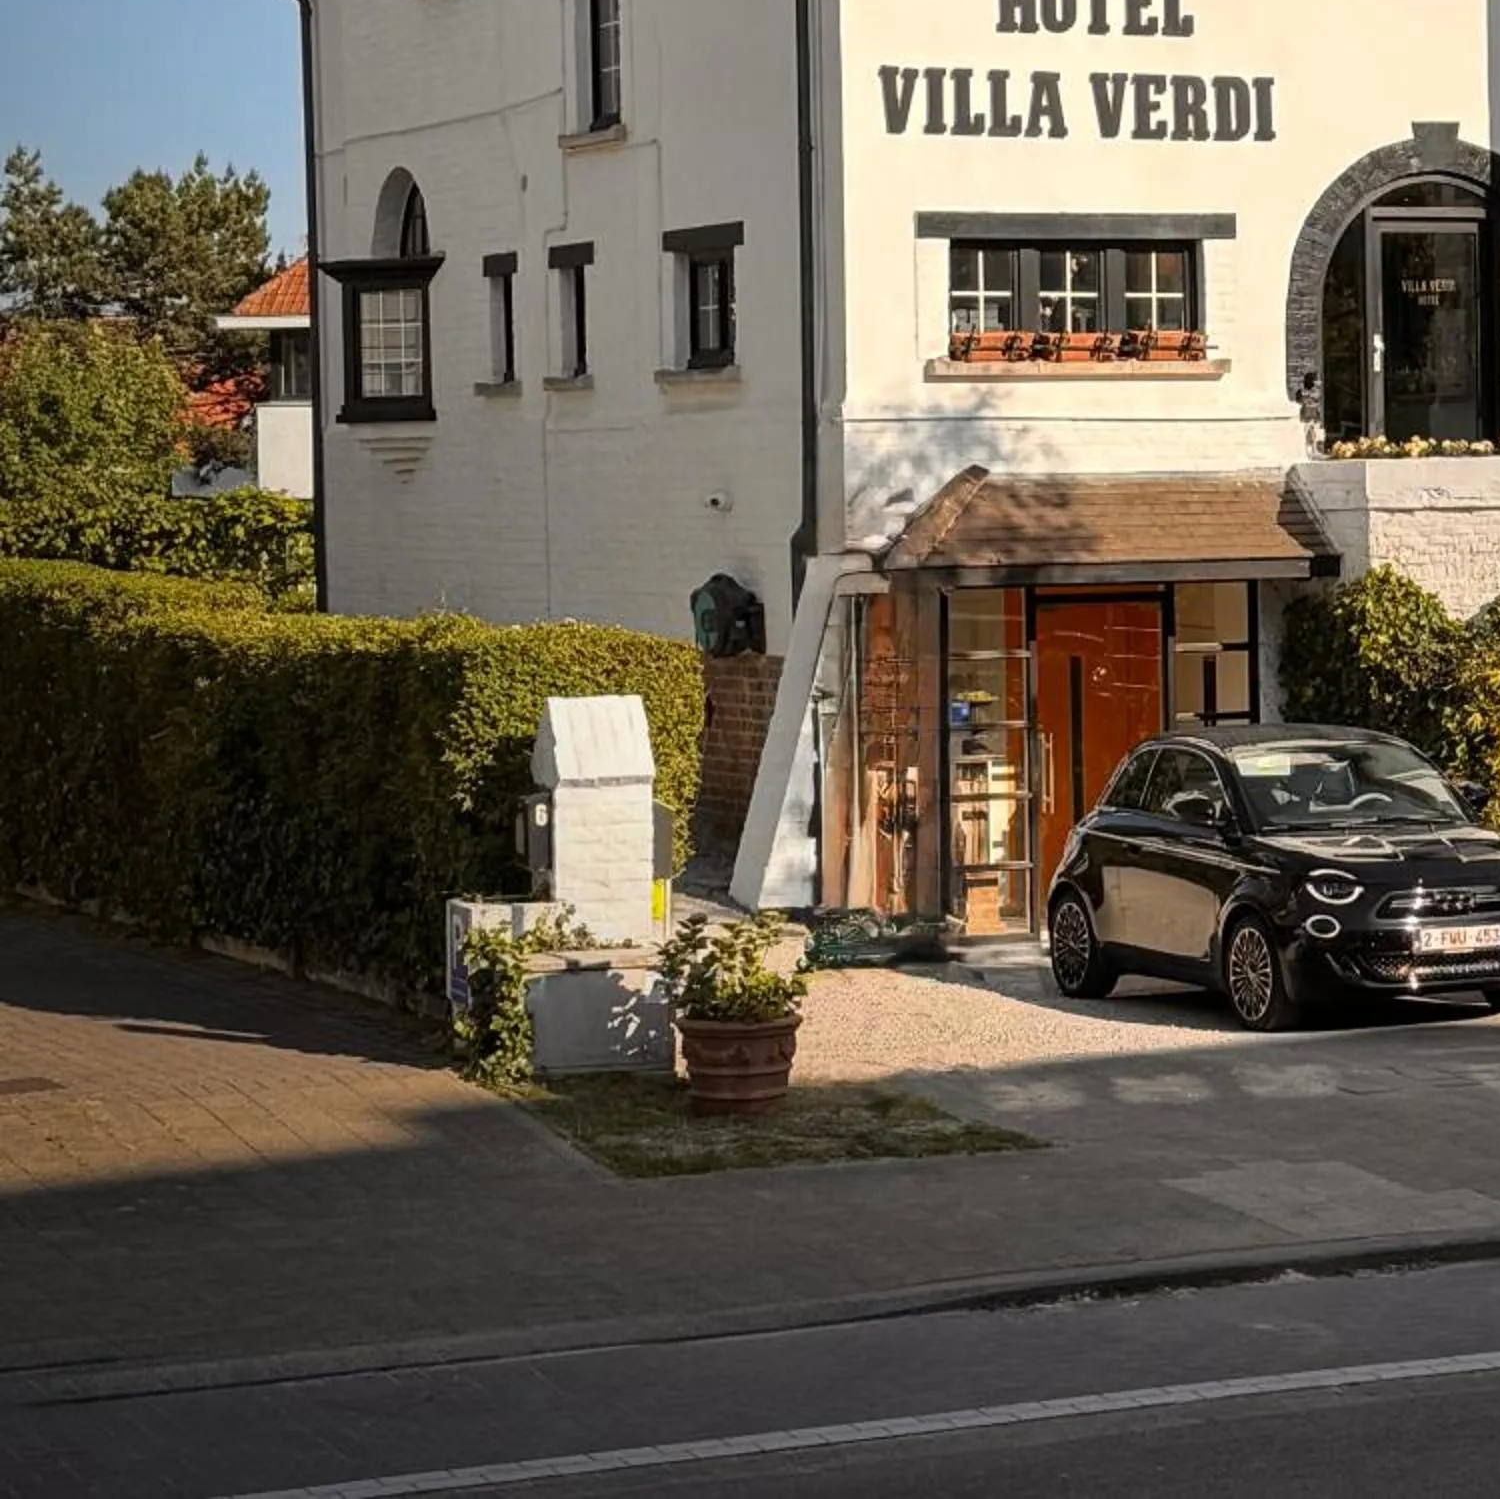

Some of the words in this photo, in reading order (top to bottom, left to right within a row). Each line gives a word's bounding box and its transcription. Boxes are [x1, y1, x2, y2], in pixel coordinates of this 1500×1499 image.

[878, 65, 1068, 138] VILLA
[1089, 73, 1276, 141] VERDI
[535, 803, 548, 826] 6
